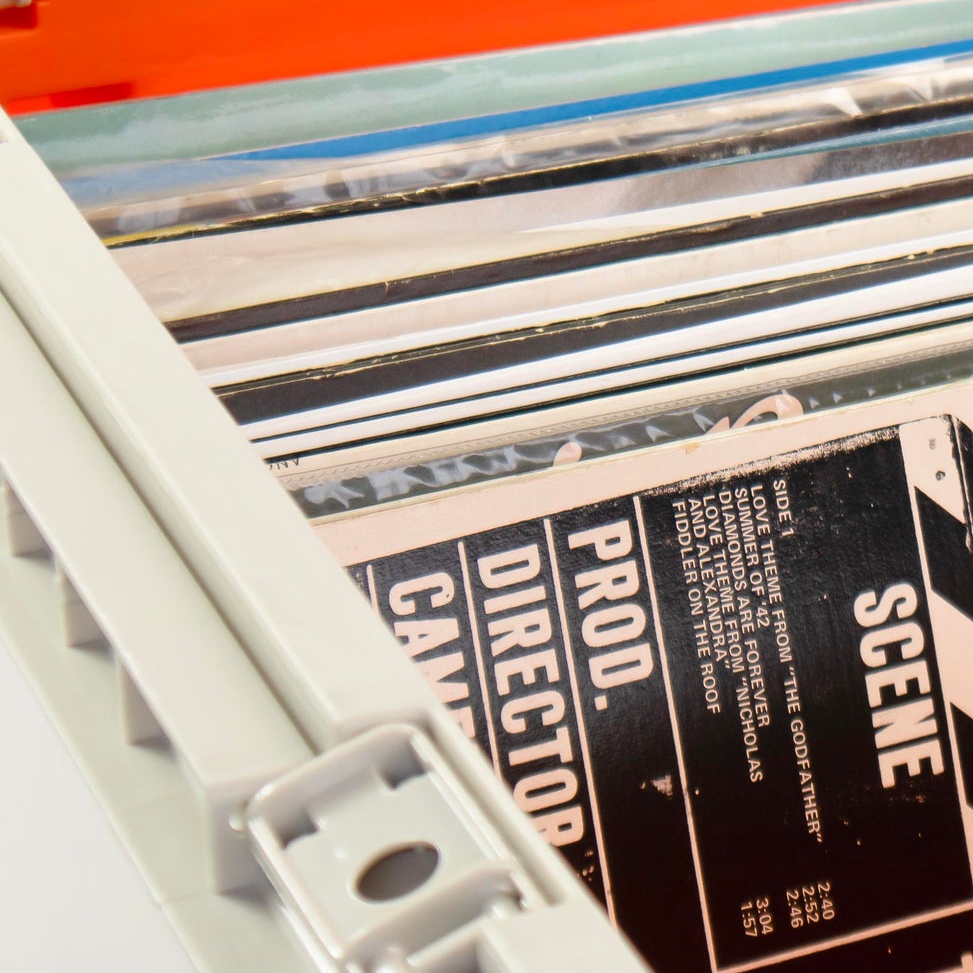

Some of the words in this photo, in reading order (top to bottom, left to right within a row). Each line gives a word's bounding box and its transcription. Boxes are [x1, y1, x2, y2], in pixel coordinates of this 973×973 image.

[687, 498, 706, 538] AND
[702, 494, 723, 545] LOVE
[772, 478, 794, 523] SIDE
[671, 498, 698, 584] FIDDLER
[718, 490, 747, 591] DIAMONDS
[734, 486, 759, 566] SUMMER
[749, 569, 765, 596] OF
[780, 526, 794, 538] 1
[712, 548, 734, 614] THEME
[750, 484, 770, 535] LOVE
[760, 538, 782, 604] THEME
[771, 608, 792, 662] FROM
[567, 519, 654, 711] PROD.
[687, 587, 703, 615] ON
[736, 595, 754, 634] ARE
[388, 571, 476, 739] CAM
[693, 618, 710, 658] THE
[723, 617, 745, 673] FROM
[476, 543, 585, 848] DIRECTOR
[700, 661, 720, 714] ROOF
[743, 638, 770, 727] FOREVER
[853, 582, 945, 789] SCENE
[740, 901, 757, 936] 1:57
[755, 897, 773, 935] 3:04
[785, 889, 803, 928] 2:46
[801, 885, 819, 923] 2:52
[817, 881, 835, 920] 2:40
